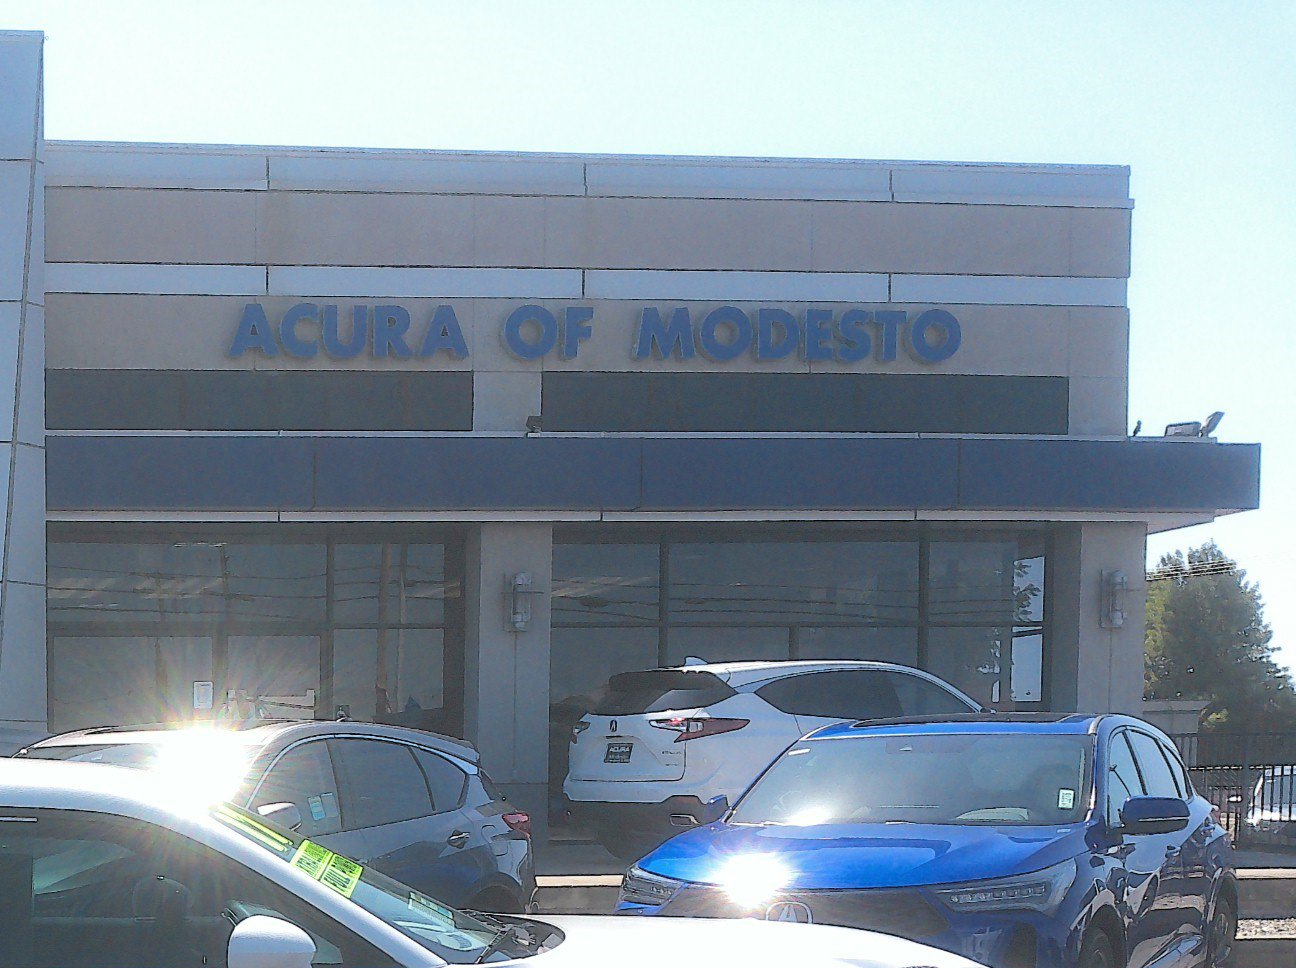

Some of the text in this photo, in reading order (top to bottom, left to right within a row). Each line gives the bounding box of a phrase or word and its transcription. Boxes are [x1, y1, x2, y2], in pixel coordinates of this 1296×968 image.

[229, 303, 962, 364] ACURA OF MODESTO
